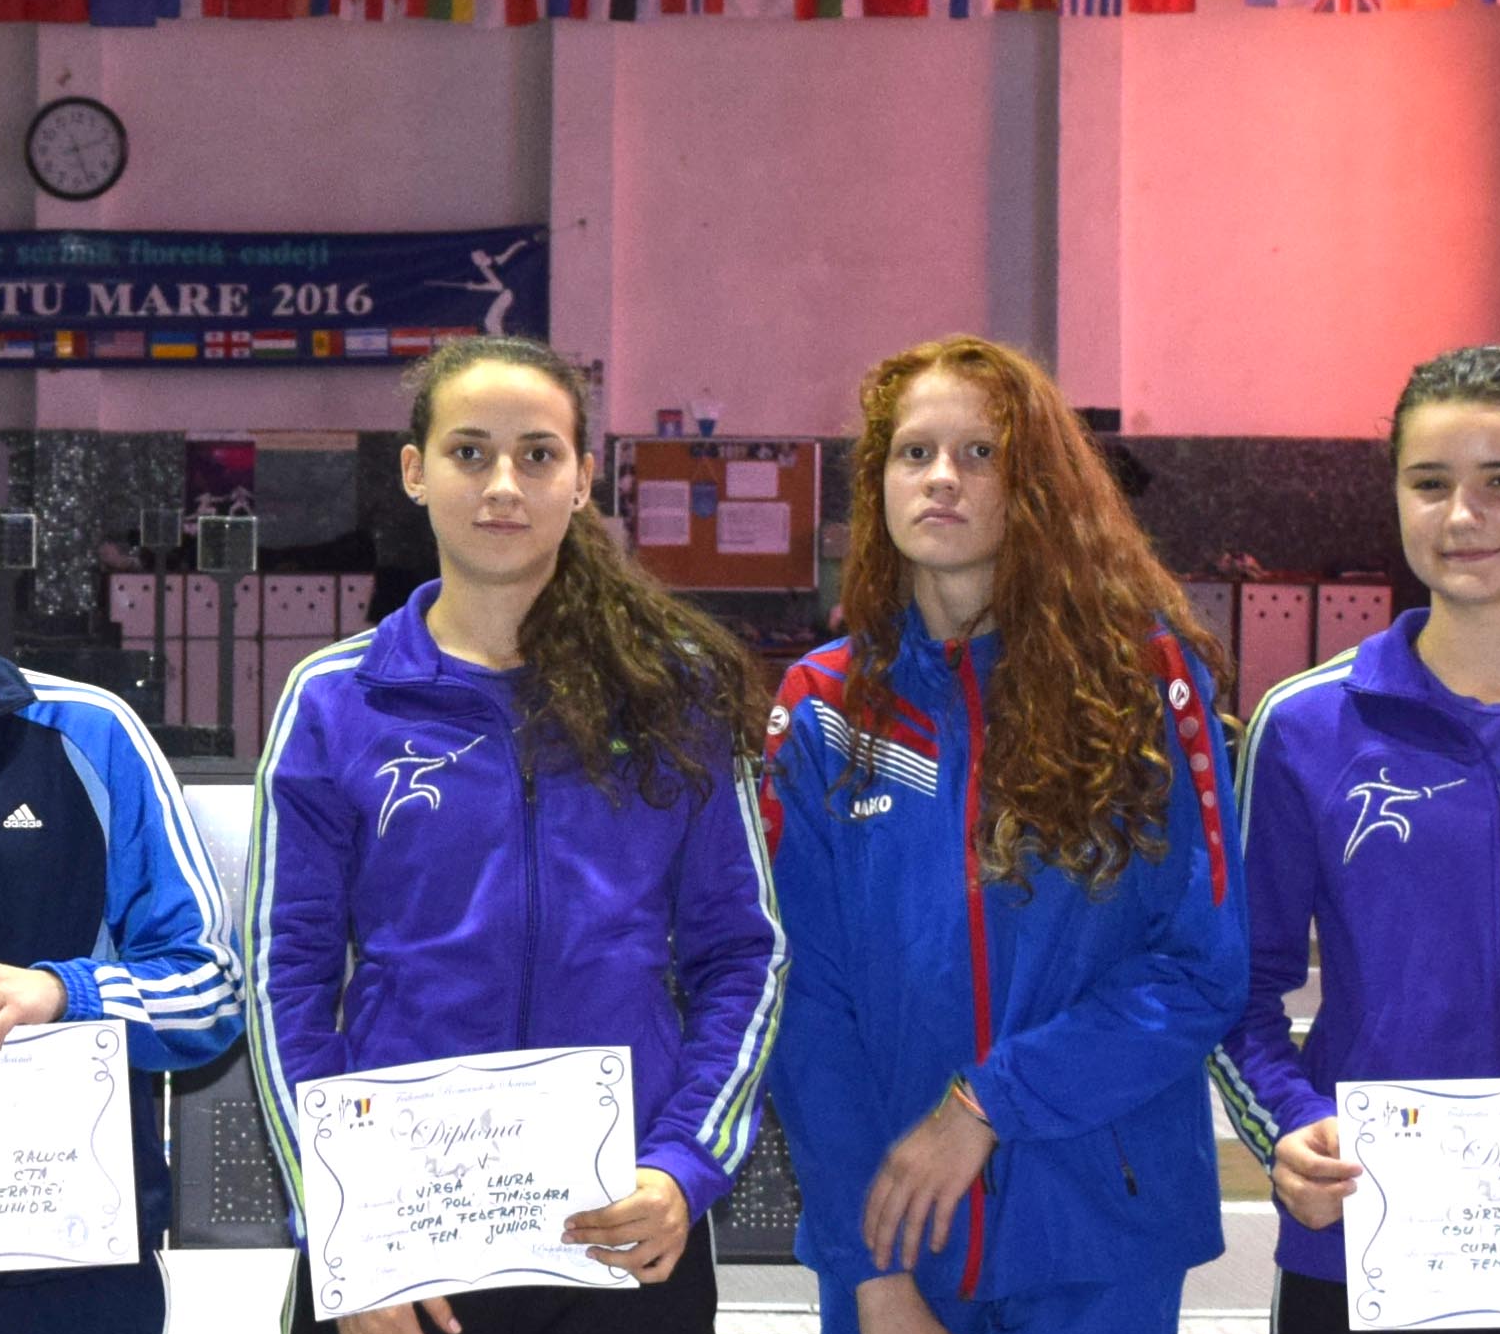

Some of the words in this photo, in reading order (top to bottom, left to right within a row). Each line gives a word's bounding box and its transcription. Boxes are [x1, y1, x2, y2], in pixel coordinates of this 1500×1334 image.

[87, 282, 249, 317] MARE
[272, 282, 373, 317] 2016
[12, 1148, 79, 1164] RALUCA
[14, 1167, 48, 1181] CTA
[487, 1171, 535, 1189] LAURA
[397, 1202, 426, 1217] CSU
[410, 1214, 443, 1233] CUPA
[1441, 1224, 1475, 1236] CSU
[1460, 1241, 1498, 1254] CUPA
